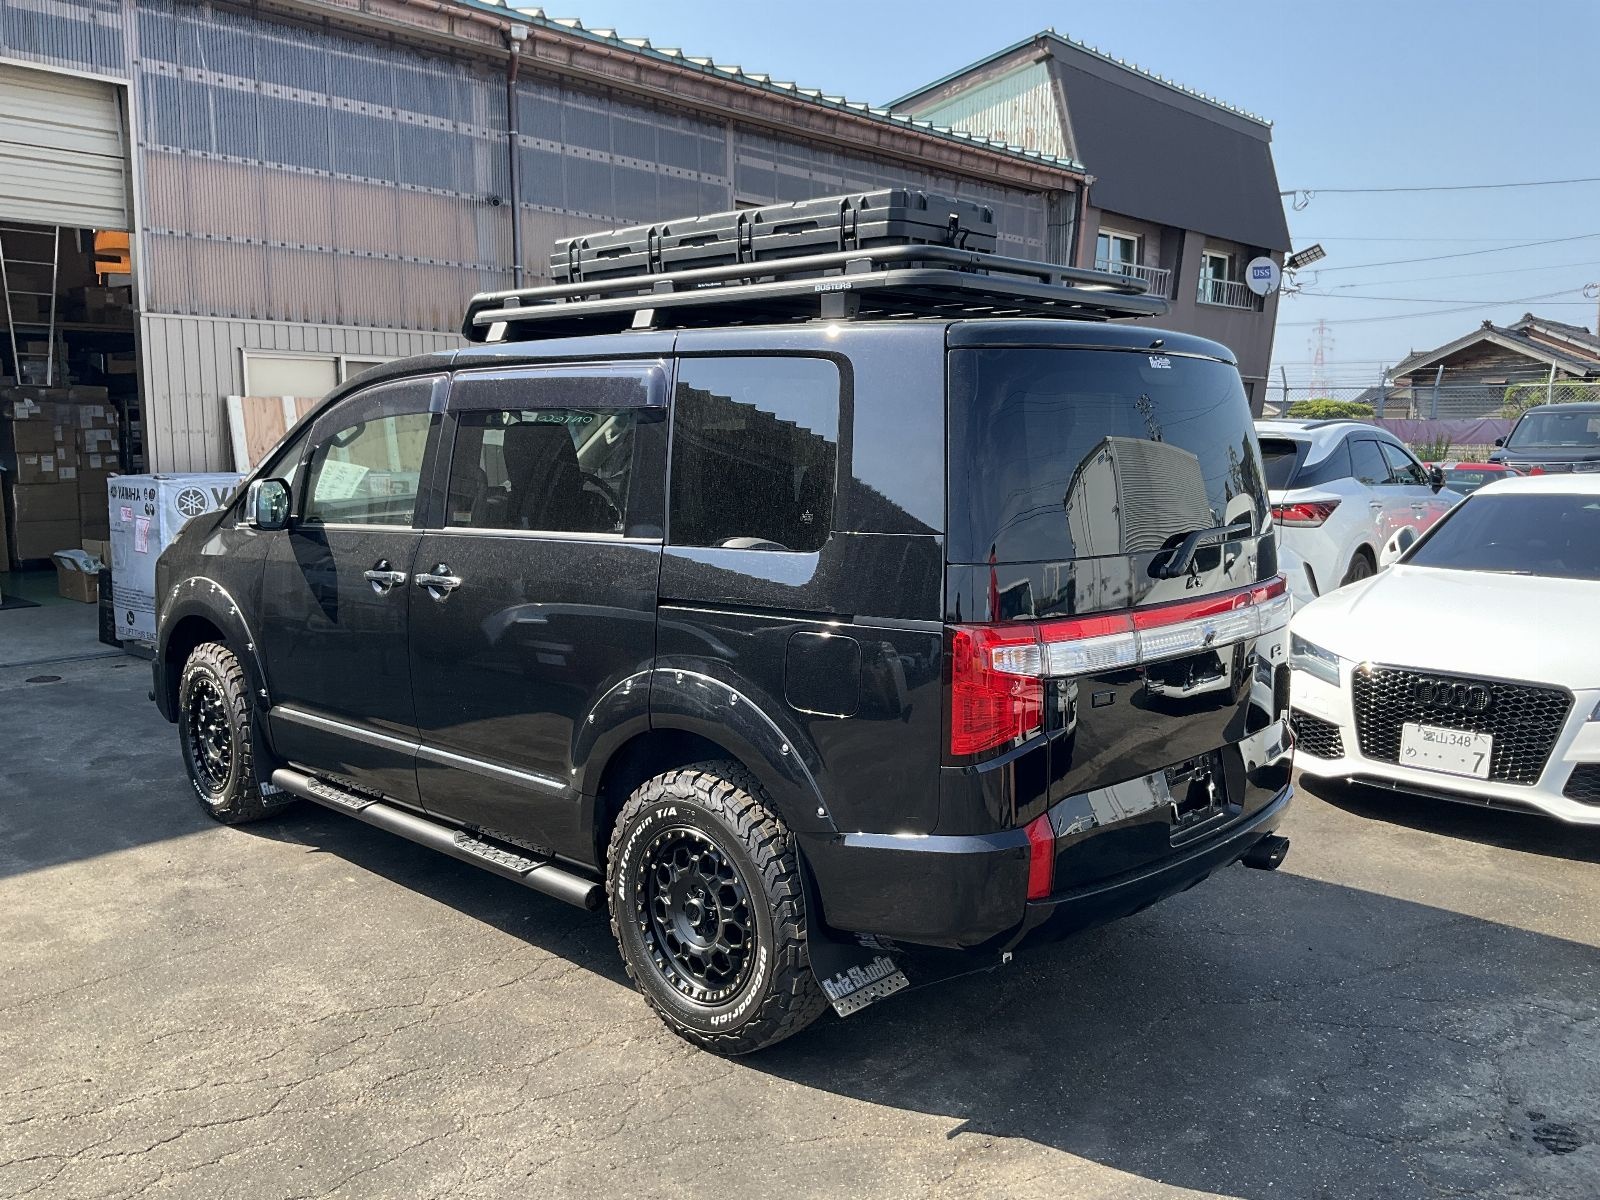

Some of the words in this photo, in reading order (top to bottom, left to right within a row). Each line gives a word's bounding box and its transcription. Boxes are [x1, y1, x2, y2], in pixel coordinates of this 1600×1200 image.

[814, 282, 852, 292] BUSTERS
[118, 486, 141, 502] YAMAHA
[618, 816, 653, 901] All-Terrain
[655, 807, 678, 819] T/A
[710, 945, 767, 1027] BFGoodrich
